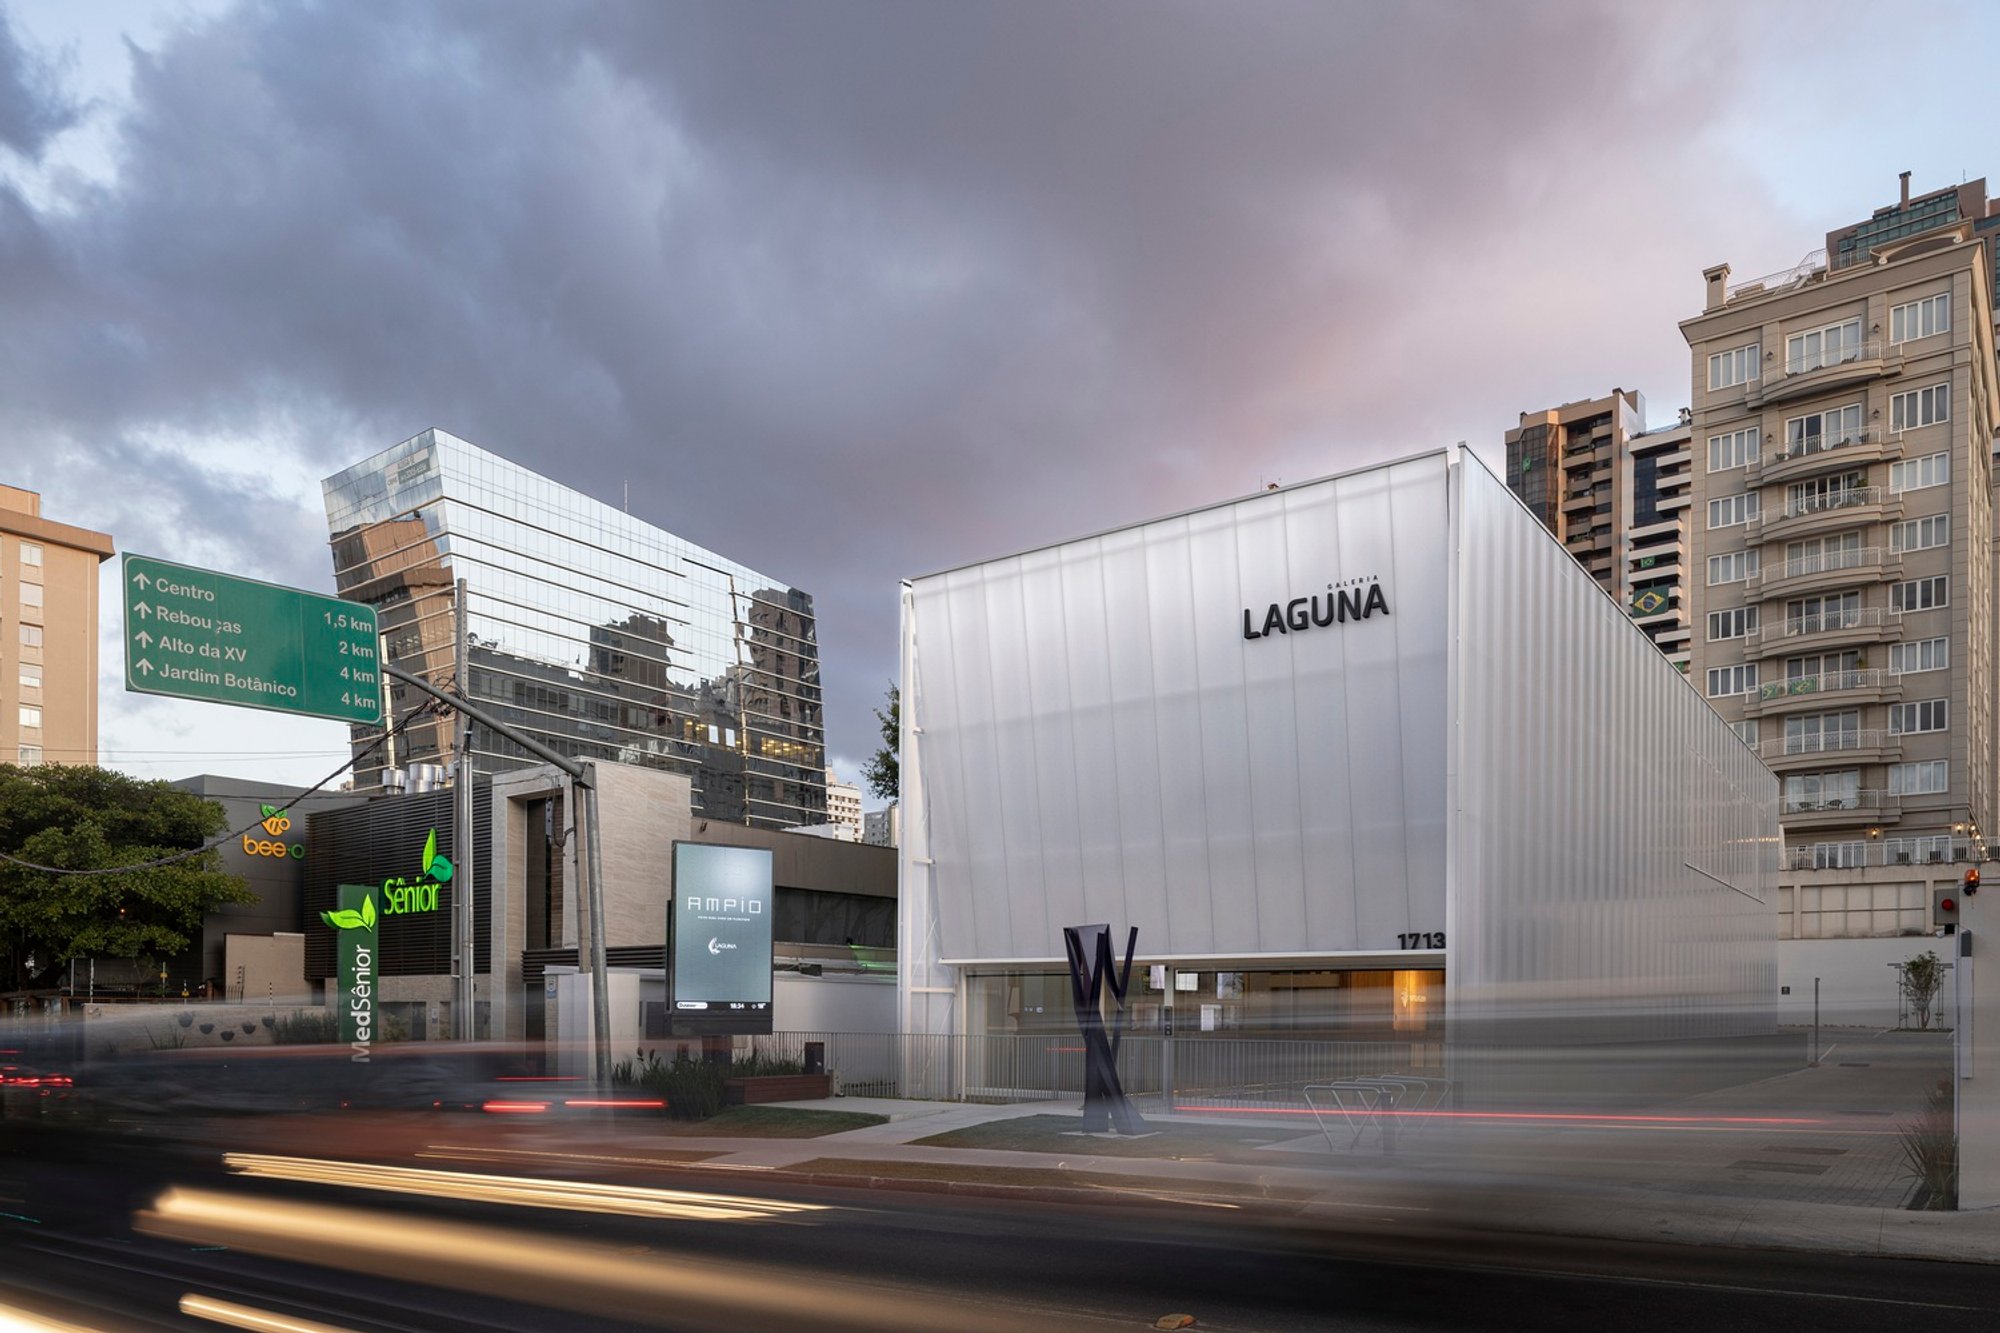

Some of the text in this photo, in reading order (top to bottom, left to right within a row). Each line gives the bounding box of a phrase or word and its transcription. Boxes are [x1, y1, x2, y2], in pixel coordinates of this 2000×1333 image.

[156, 578, 215, 602] Centro
[1327, 574, 1379, 590] GALERIA
[324, 612, 373, 633] 1,5 km
[1244, 583, 1390, 640] LAGUNA
[159, 635, 247, 662] Alto da XV
[339, 641, 374, 658] 2 km
[159, 663, 297, 698] Jardim Botânico
[340, 666, 375, 684] 4 km
[341, 692, 376, 710] 4 km
[384, 876, 441, 915] Sênior
[1397, 932, 1446, 951] 1713
[351, 944, 371, 1063] MedSênior
